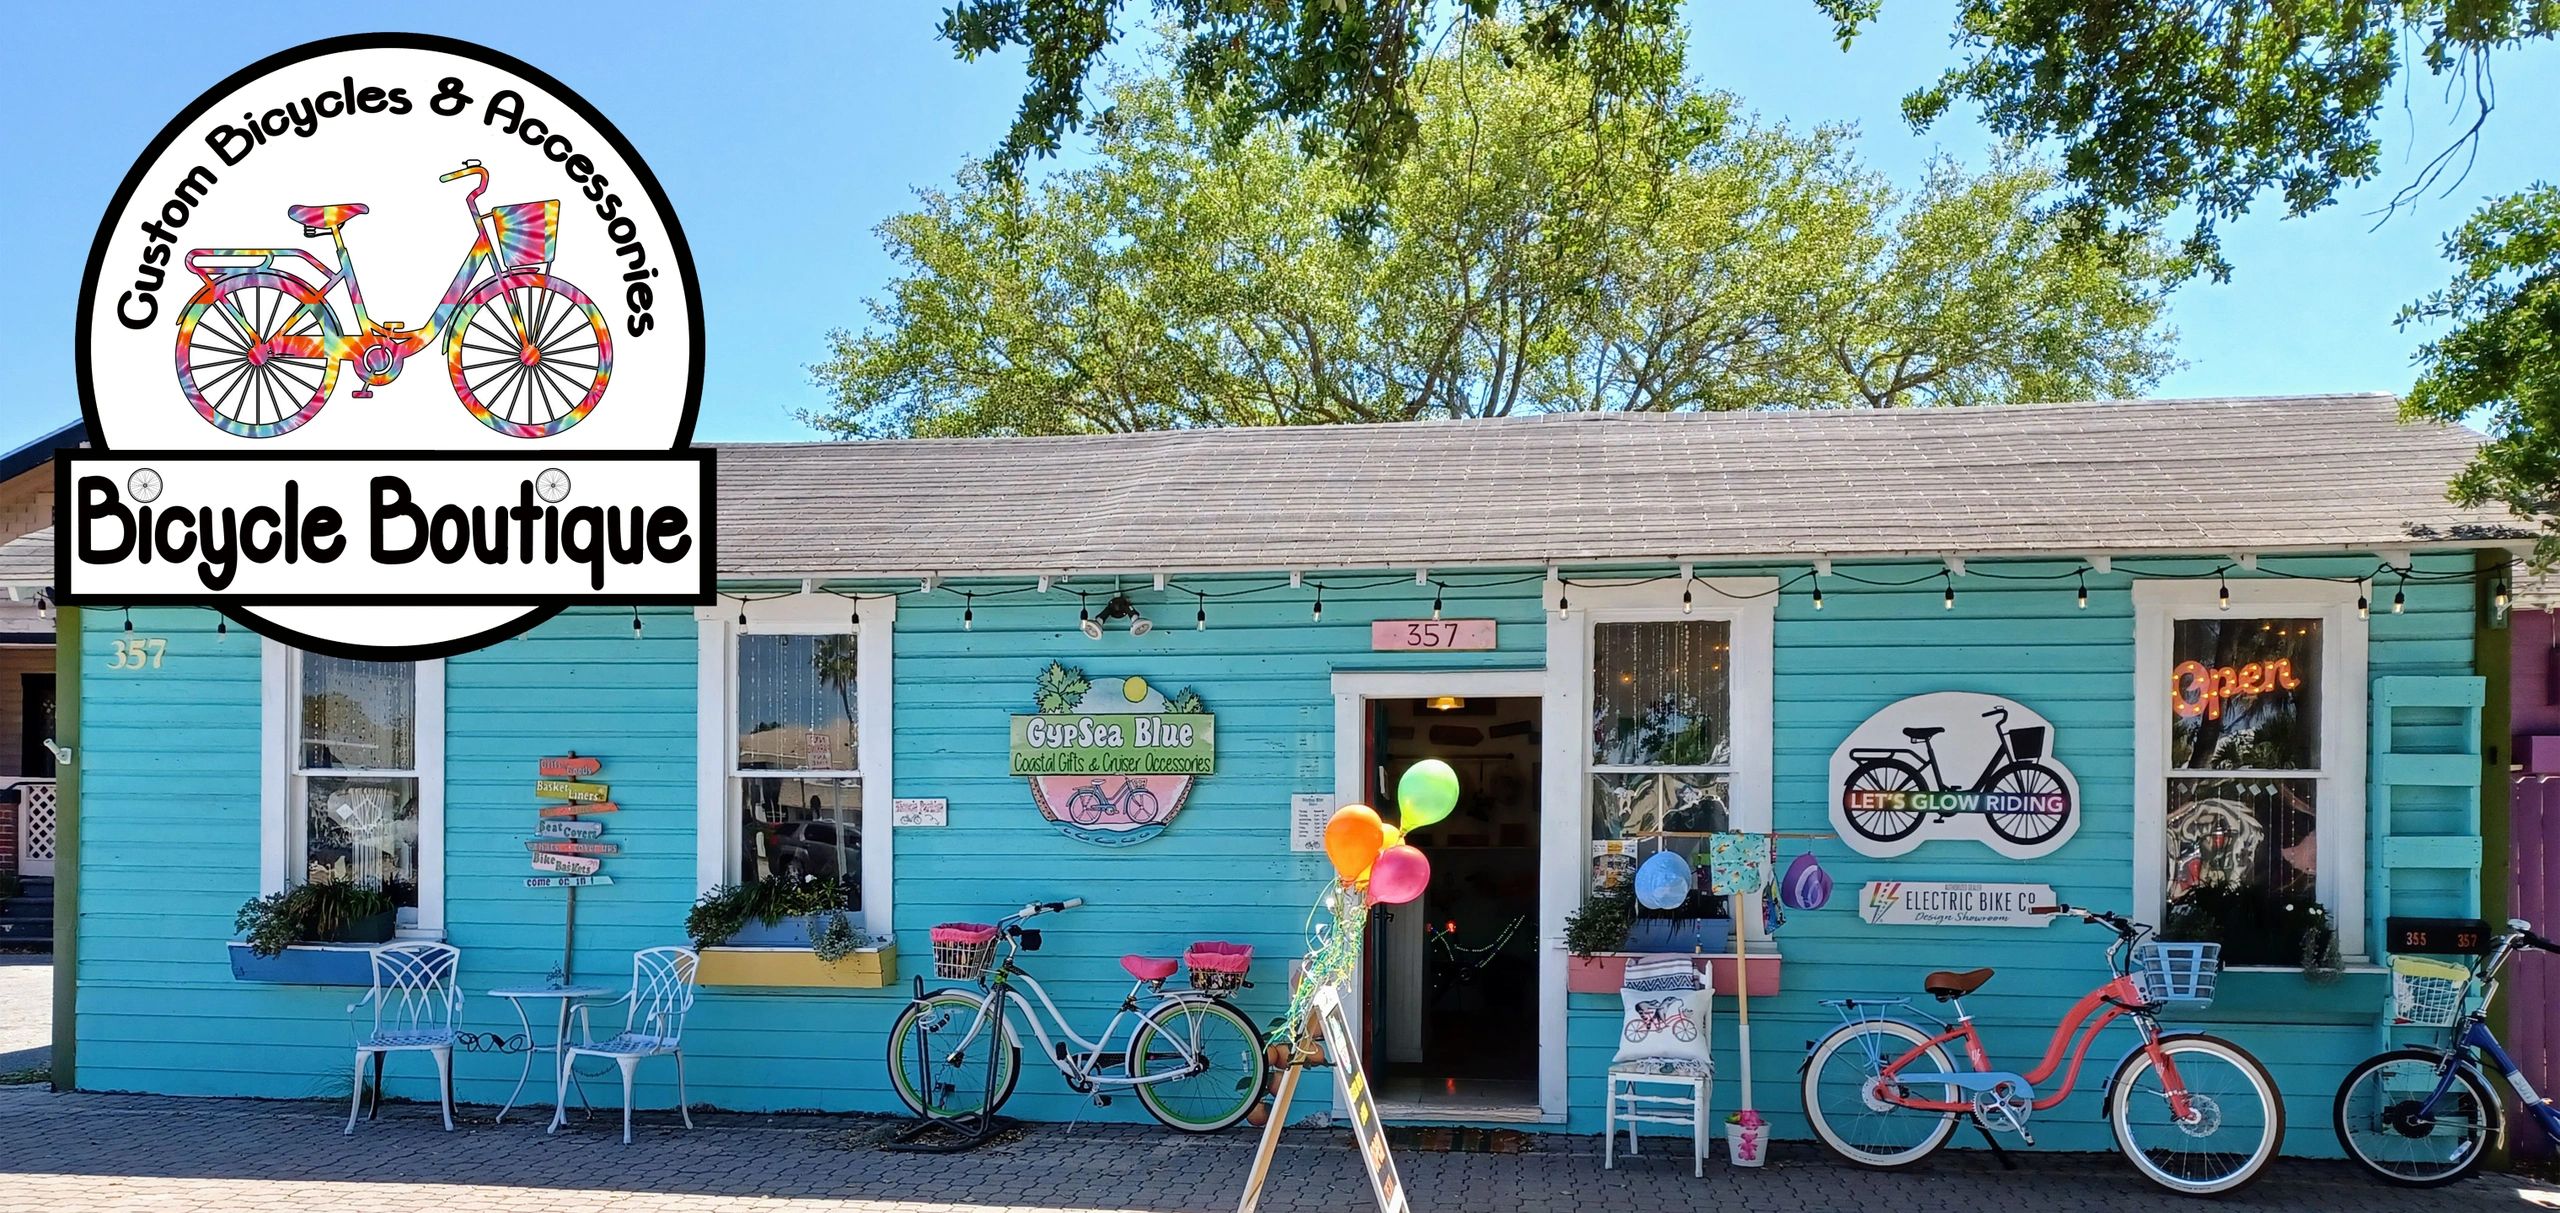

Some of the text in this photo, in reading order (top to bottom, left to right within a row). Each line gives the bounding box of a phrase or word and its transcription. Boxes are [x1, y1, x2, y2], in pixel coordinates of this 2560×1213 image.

[1408, 624, 1458, 647] 357
[106, 638, 168, 670] 357
[2172, 658, 2300, 721] Open
[1026, 716, 1194, 748] GypSea Blue
[1014, 752, 1211, 772] Coastal Gifts & Cruiser Accessories
[536, 781, 598, 801] Basket Liners
[1912, 794, 1979, 811] GLOW
[1986, 795, 2064, 813] RIDING
[539, 820, 598, 839] Seat Covers
[533, 852, 556, 864] Bike
[526, 877, 551, 887] come
[558, 876, 570, 886] on
[1906, 890, 1974, 911] ELECTRIC
[1979, 891, 2012, 912] BIKE
[1914, 911, 2010, 925] Design Showroom
[2406, 931, 2427, 946] 355
[2457, 933, 2477, 948] 357
